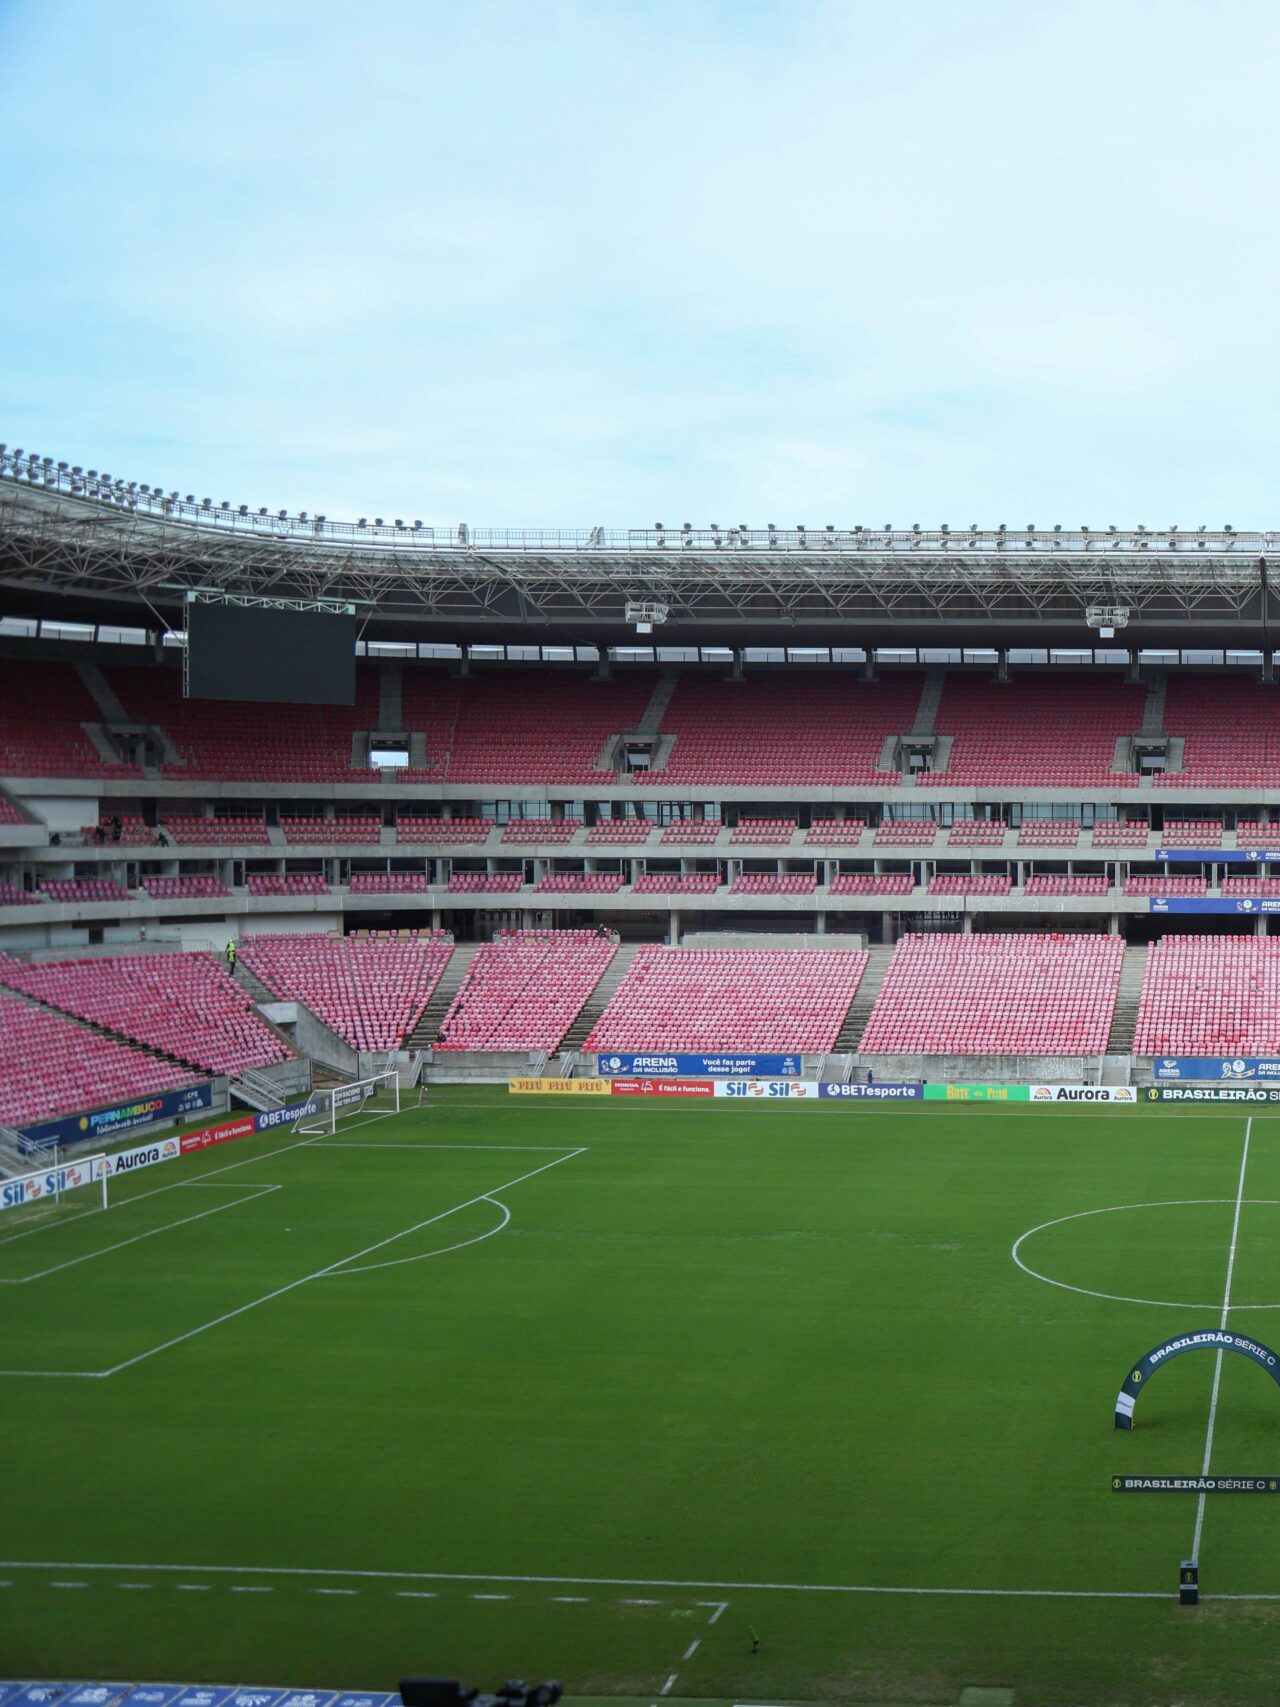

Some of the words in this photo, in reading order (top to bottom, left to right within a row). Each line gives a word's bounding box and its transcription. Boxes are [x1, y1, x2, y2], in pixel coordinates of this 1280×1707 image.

[633, 1058, 677, 1066] ARENA
[735, 1059, 756, 1067] parte
[730, 1066, 750, 1074] jogo!
[726, 1082, 747, 1096] Sil
[769, 1082, 790, 1096] Sil
[841, 1085, 916, 1098] BETesporte
[1056, 1088, 1110, 1100] Aurora
[1163, 1089, 1267, 1100] BRASILEIRÃO
[91, 1100, 164, 1127] PERNAMBUCO
[116, 1148, 159, 1172] Aurora
[45, 1169, 66, 1193] Sil
[3, 1183, 24, 1207] Sil
[1149, 1333, 1233, 1364] BRASILEIRÃO
[1234, 1339, 1268, 1360] SÉRIE
[1267, 1356, 1276, 1366] C
[1125, 1479, 1215, 1489] BRASILEIRÃO
[1217, 1479, 1254, 1489] SÉRIE
[1256, 1480, 1265, 1489] C
